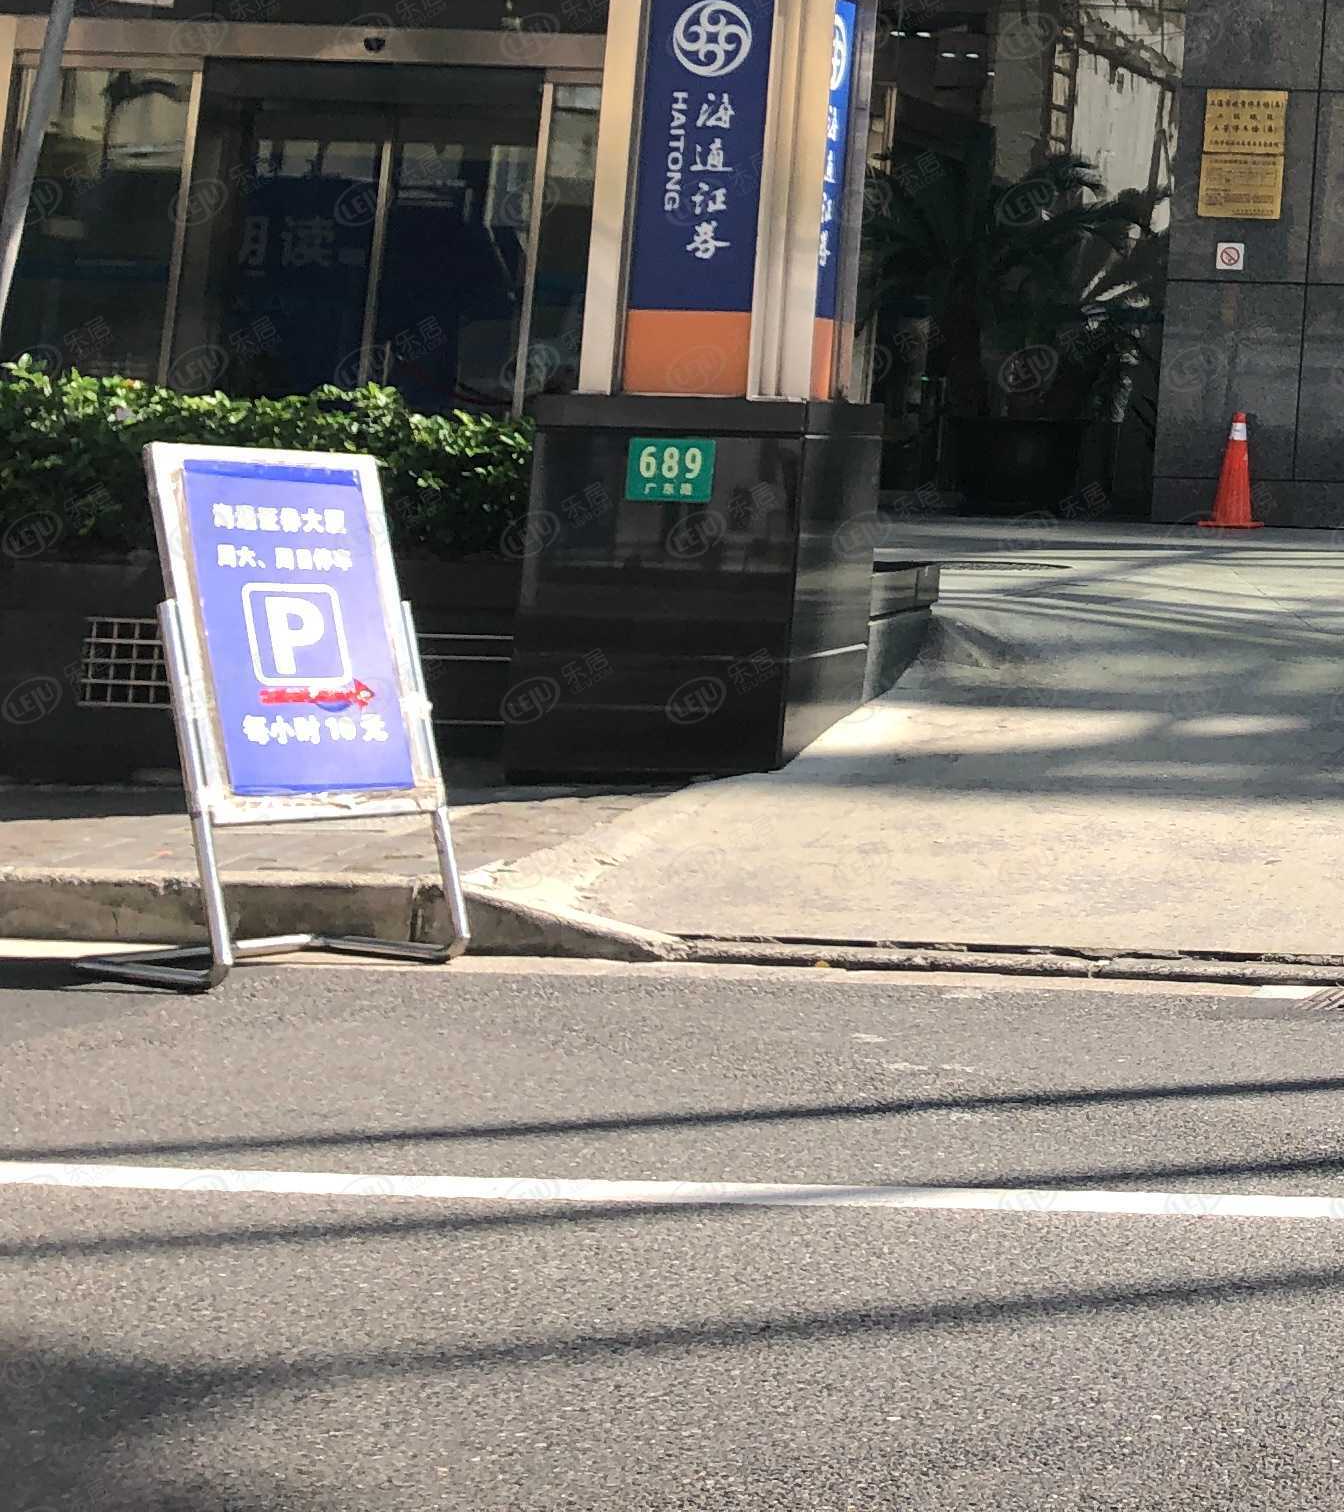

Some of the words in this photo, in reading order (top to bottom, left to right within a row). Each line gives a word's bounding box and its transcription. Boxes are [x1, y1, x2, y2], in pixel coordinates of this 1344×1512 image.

[664, 91, 688, 211] HAITONG
[686, 93, 735, 259] 海通证券
[639, 445, 702, 479] 689
[264, 596, 325, 674] P
